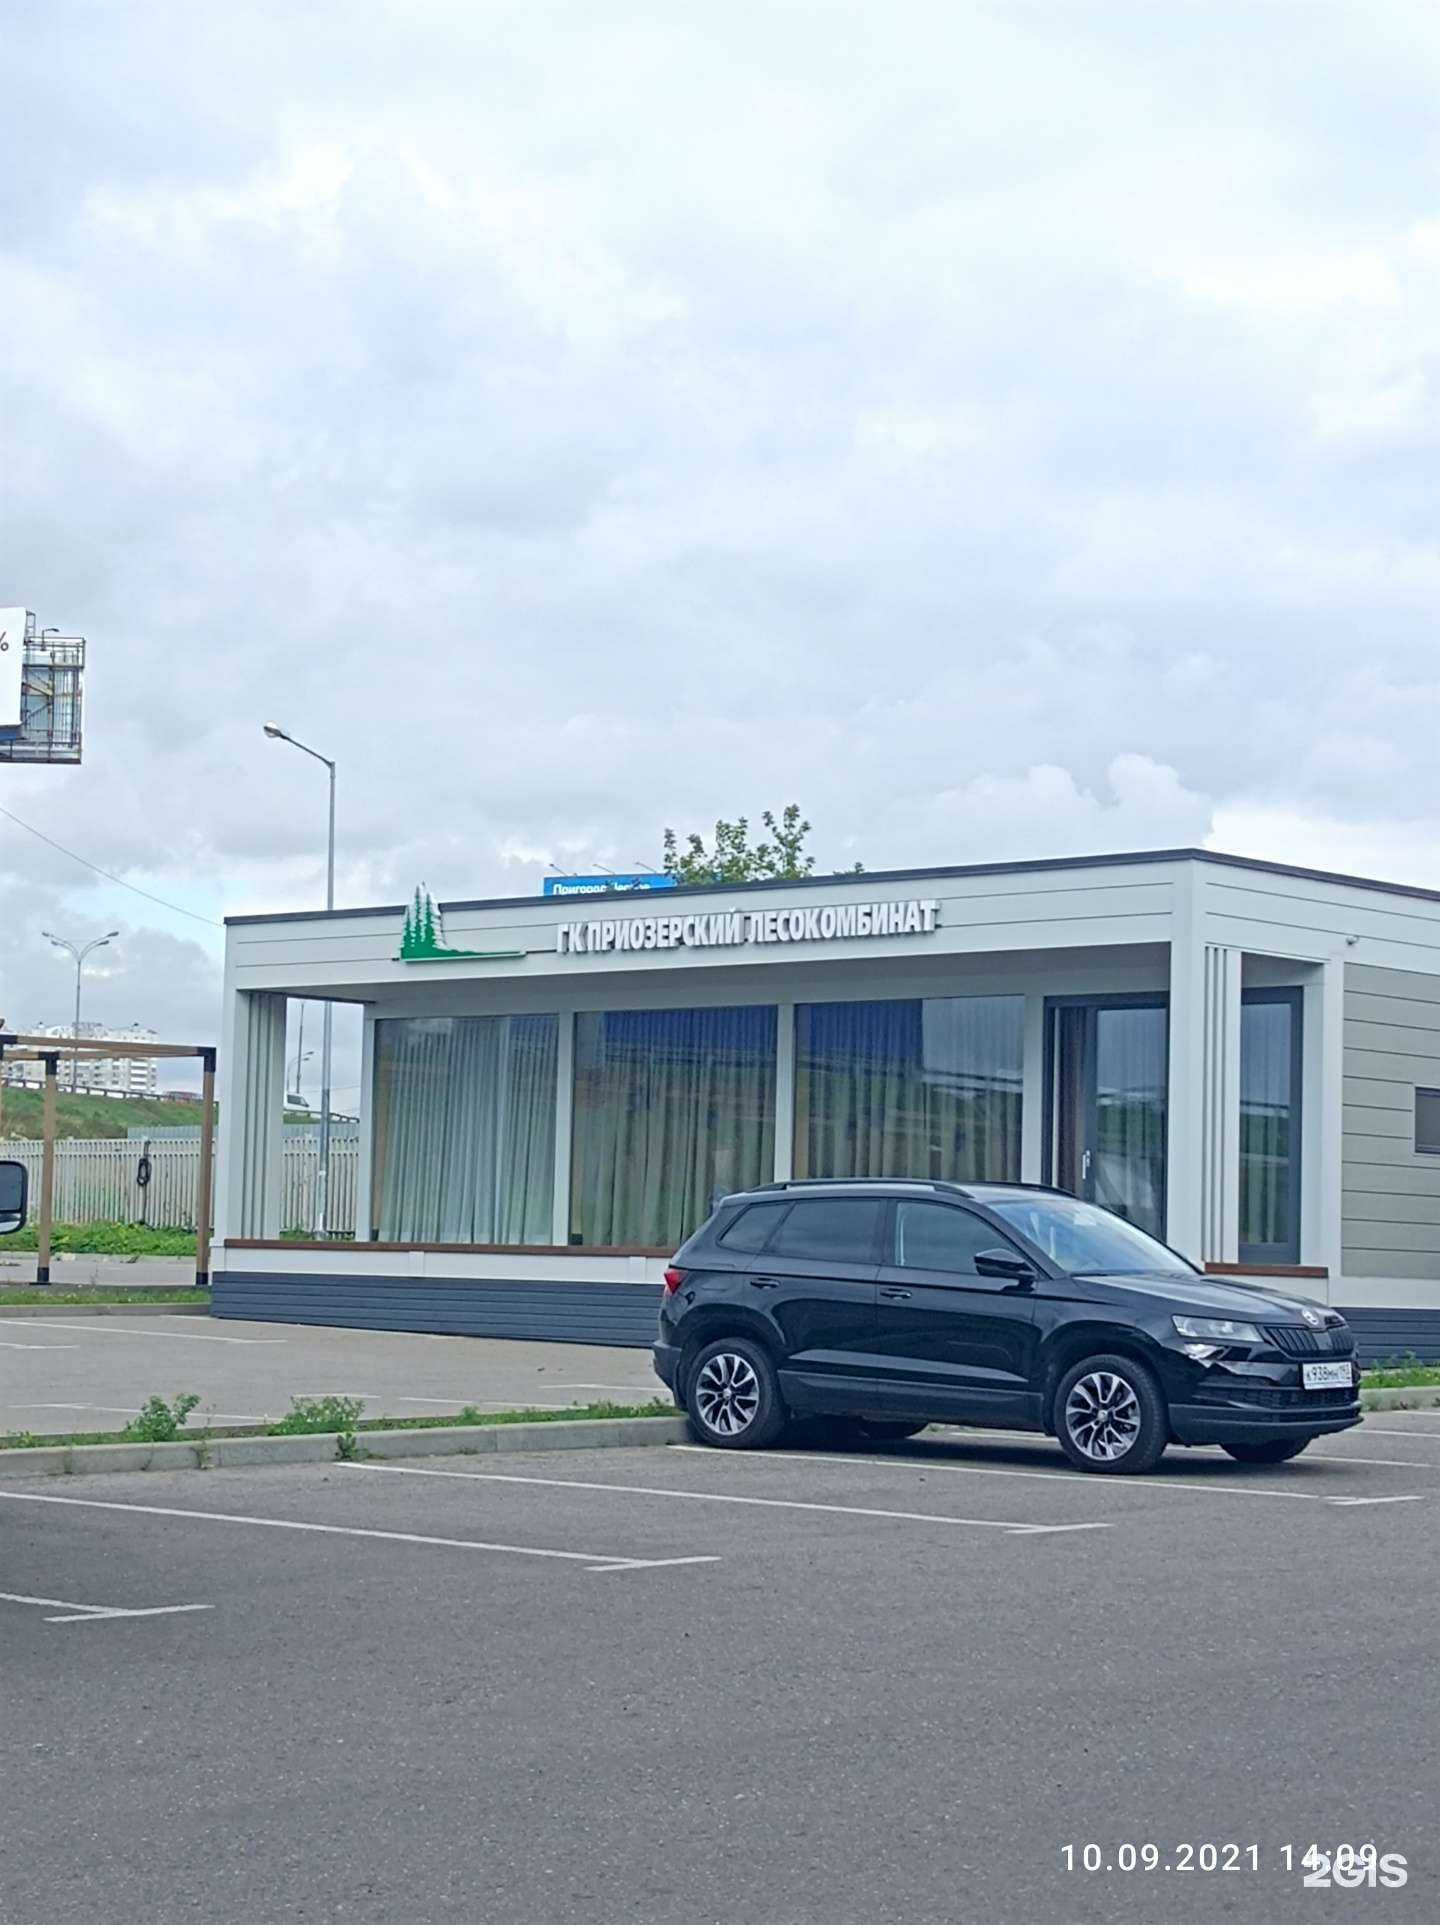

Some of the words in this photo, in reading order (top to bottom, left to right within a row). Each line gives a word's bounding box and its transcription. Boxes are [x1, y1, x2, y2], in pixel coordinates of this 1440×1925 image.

[556, 922, 588, 953] ГК
[587, 907, 743, 951] ПРИОЗЕРСКИЙ
[748, 899, 938, 944] ЛЕСОКОМБИНАТ
